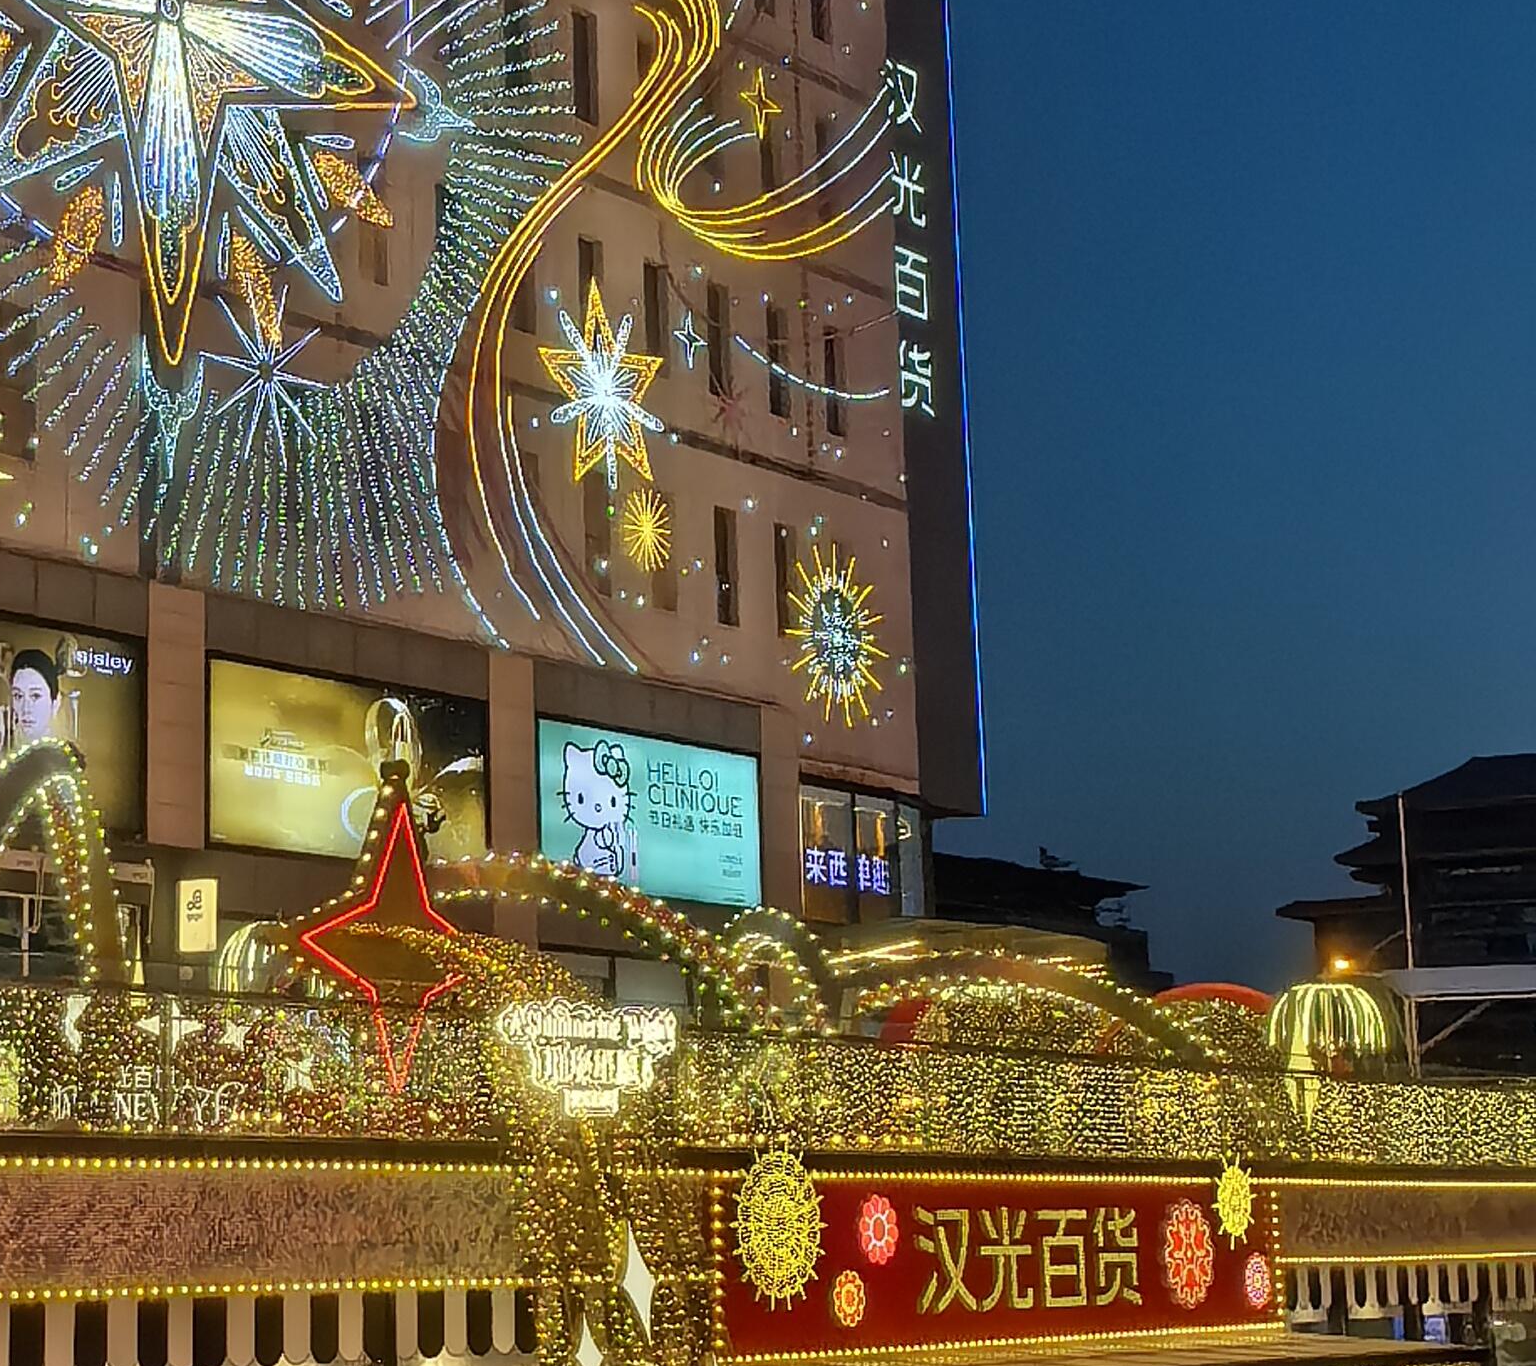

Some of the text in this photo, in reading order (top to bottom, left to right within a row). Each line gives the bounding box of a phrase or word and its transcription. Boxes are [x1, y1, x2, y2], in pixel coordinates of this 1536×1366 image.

[880, 58, 935, 418] 汉光百货
[75, 647, 133, 674] sisley
[916, 1206, 1143, 1315] 汉光百货
